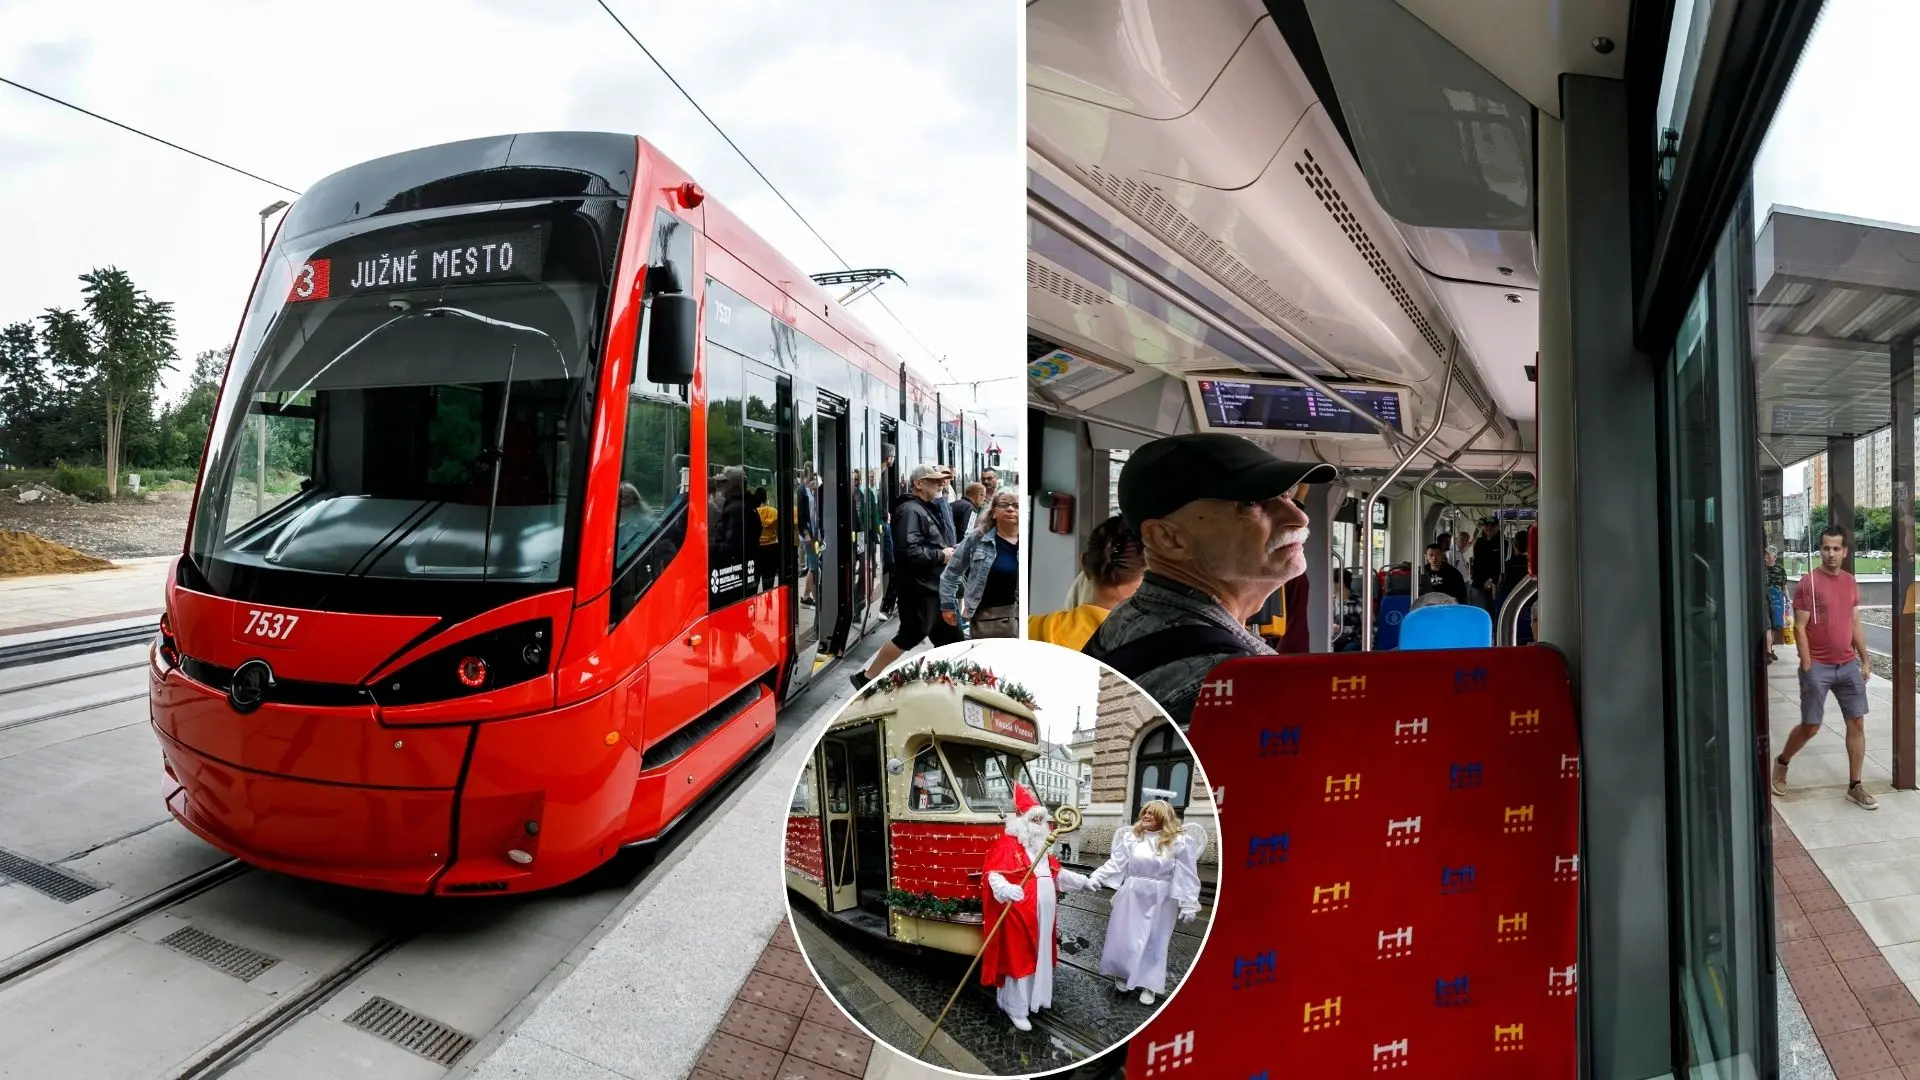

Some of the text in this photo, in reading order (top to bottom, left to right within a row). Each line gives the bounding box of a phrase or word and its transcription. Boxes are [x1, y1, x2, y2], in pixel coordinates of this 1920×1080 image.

[296, 242, 513, 297] 3 JUŽNÉ MESTO
[714, 300, 731, 326] 7537
[243, 609, 299, 640] 7537
